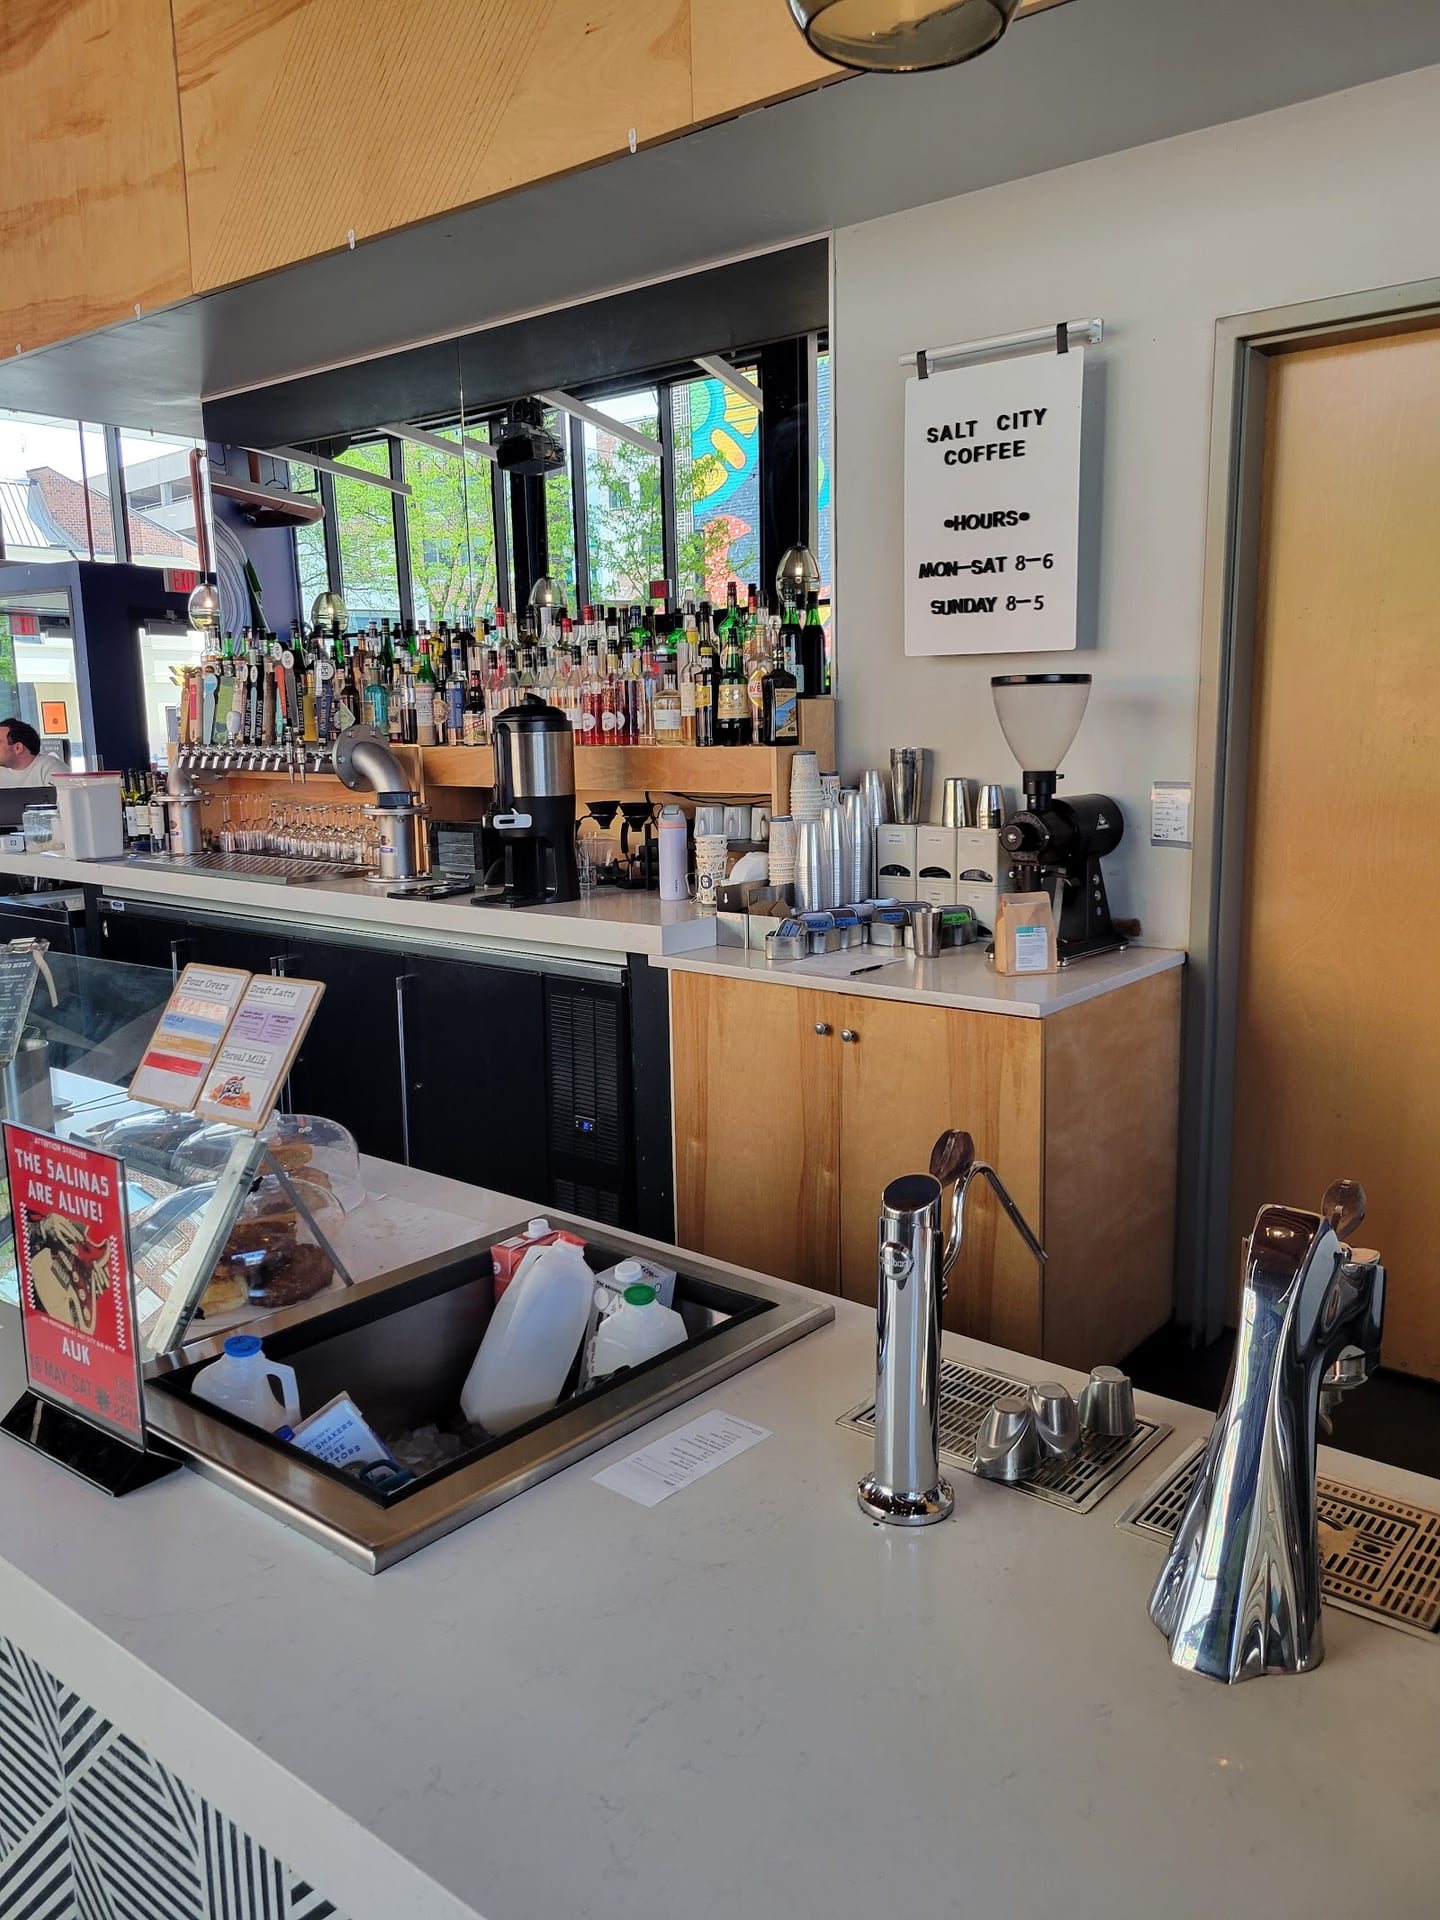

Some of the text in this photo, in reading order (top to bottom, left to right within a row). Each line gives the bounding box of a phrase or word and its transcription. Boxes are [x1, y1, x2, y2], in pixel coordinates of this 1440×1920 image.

[927, 408, 1048, 443] SALT CITY
[944, 440, 1026, 466] COFFEE
[173, 569, 196, 591] EXIT
[930, 597, 998, 615] SUNDAY
[184, 976, 205, 987] Pour
[205, 980, 230, 991] Overs
[249, 984, 296, 999] Draft Latte
[221, 1049, 268, 1066] Cereal Milk
[14, 1148, 109, 1197] THE SALINAS
[28, 1179, 104, 1224] ARE ALIVE!
[62, 1336, 91, 1366] AUK
[71, 1373, 92, 1398] SAT
[315, 1419, 354, 1450] SHAKERS
[323, 1442, 347, 1461] FFEE
[334, 1445, 361, 1463] TORS
